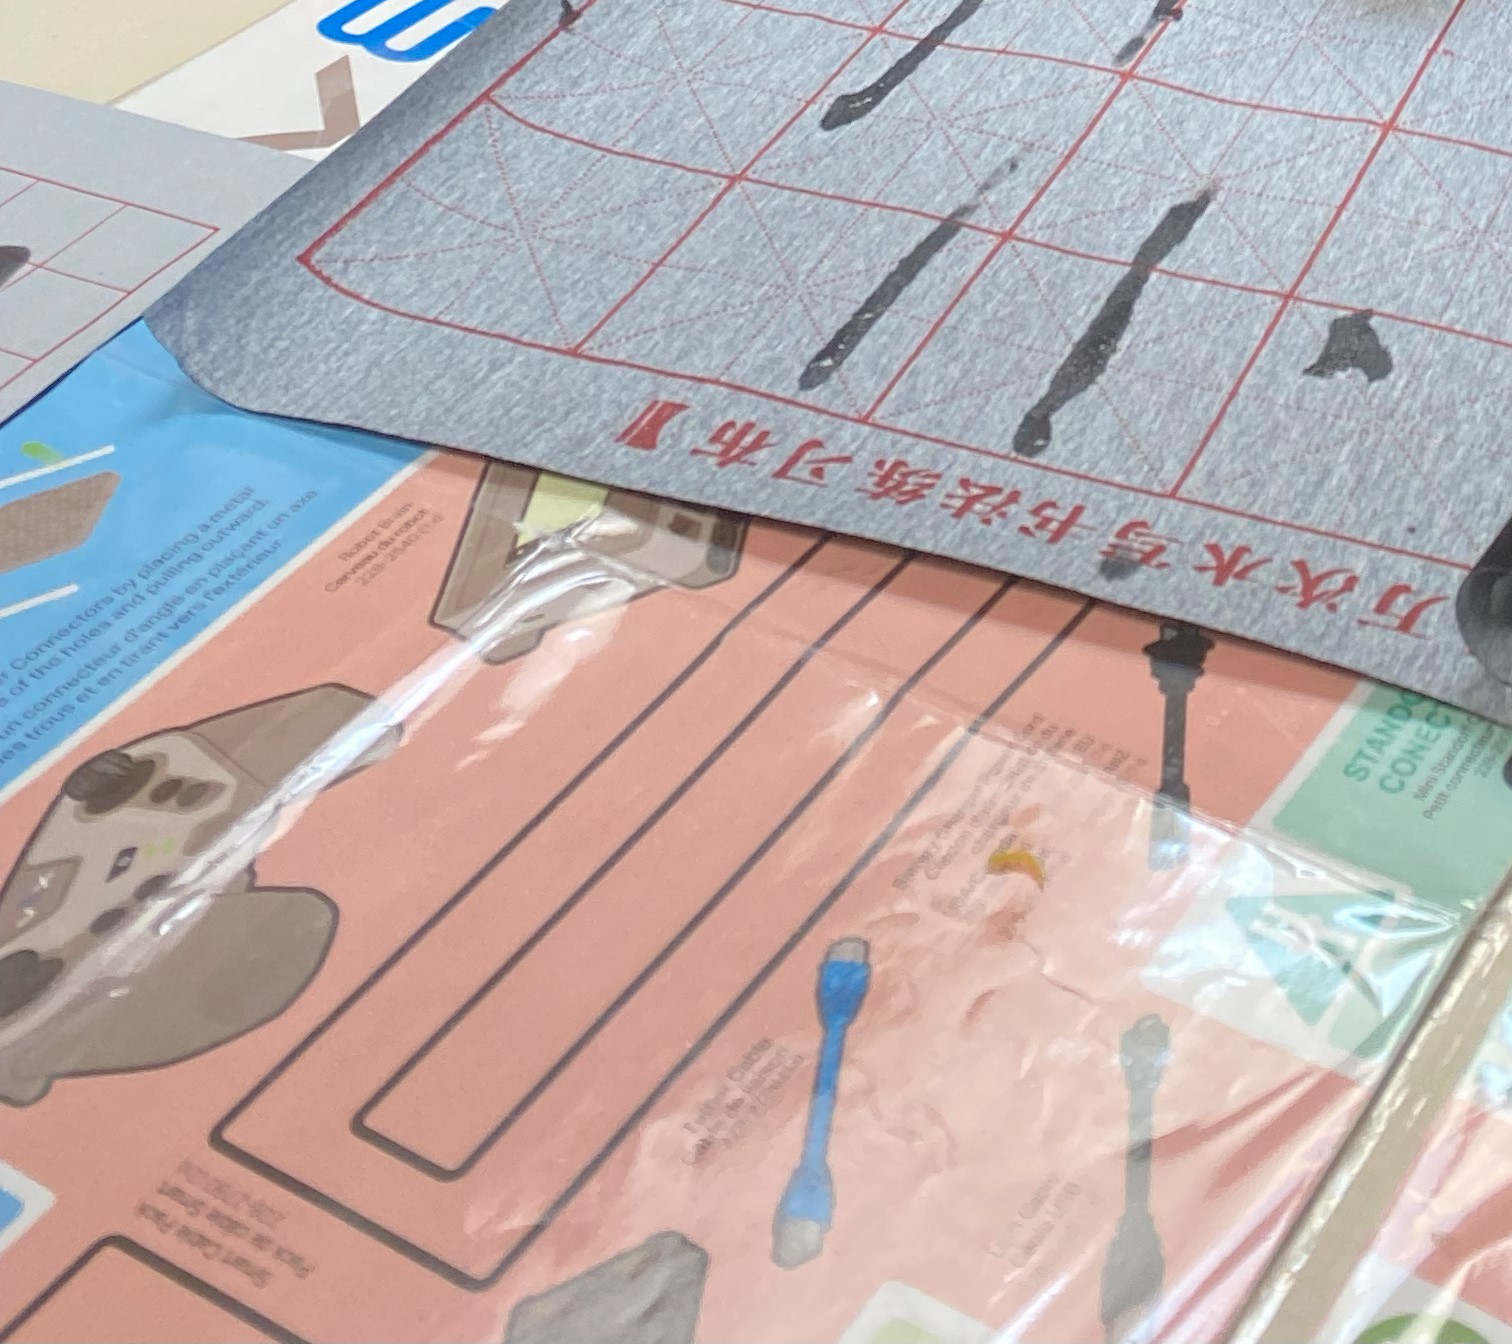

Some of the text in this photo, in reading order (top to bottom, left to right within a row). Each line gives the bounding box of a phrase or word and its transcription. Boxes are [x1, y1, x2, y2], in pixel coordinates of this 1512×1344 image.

[6, 675, 32, 699] of
[28, 651, 63, 683] the
[59, 615, 111, 660] holes
[109, 588, 147, 622] and
[143, 545, 204, 598] pulling
[8, 587, 117, 678] Connectors
[110, 574, 139, 601] by
[135, 526, 201, 583] placing
[206, 481, 256, 526] metal
[20, 638, 124, 725] connecteur
[183, 573, 210, 598] en
[25, 699, 76, 744] trous
[73, 683, 97, 706] et
[95, 663, 124, 689] en
[119, 626, 169, 670] tirant
[166, 597, 208, 633] vers
